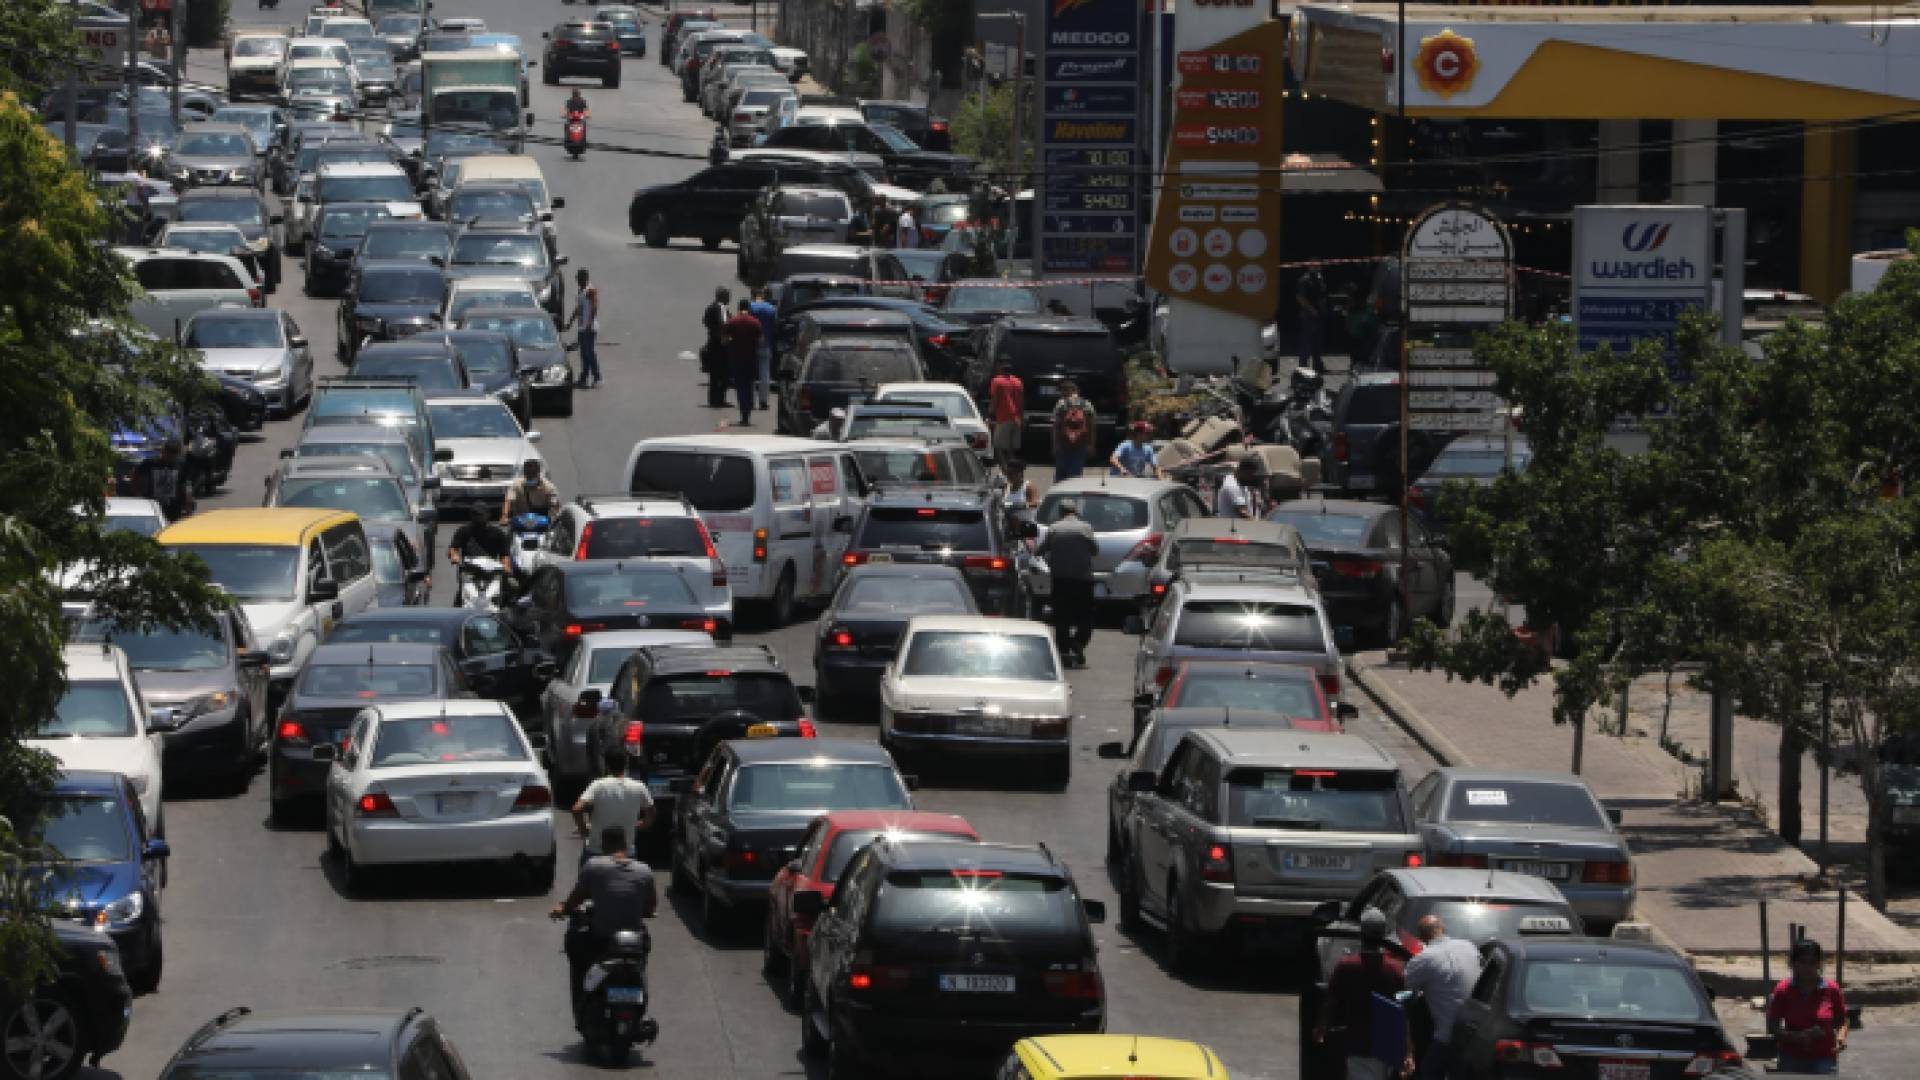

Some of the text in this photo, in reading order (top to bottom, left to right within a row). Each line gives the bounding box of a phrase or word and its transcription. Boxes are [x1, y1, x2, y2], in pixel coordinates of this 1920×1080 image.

[1052, 31, 1130, 44] MEDCO
[1433, 50, 1460, 78] C
[1055, 121, 1128, 140] Havoline
[1207, 127, 1259, 144] 54400
[1083, 193, 1129, 208] 54400
[1592, 256, 1694, 279] wardieh
